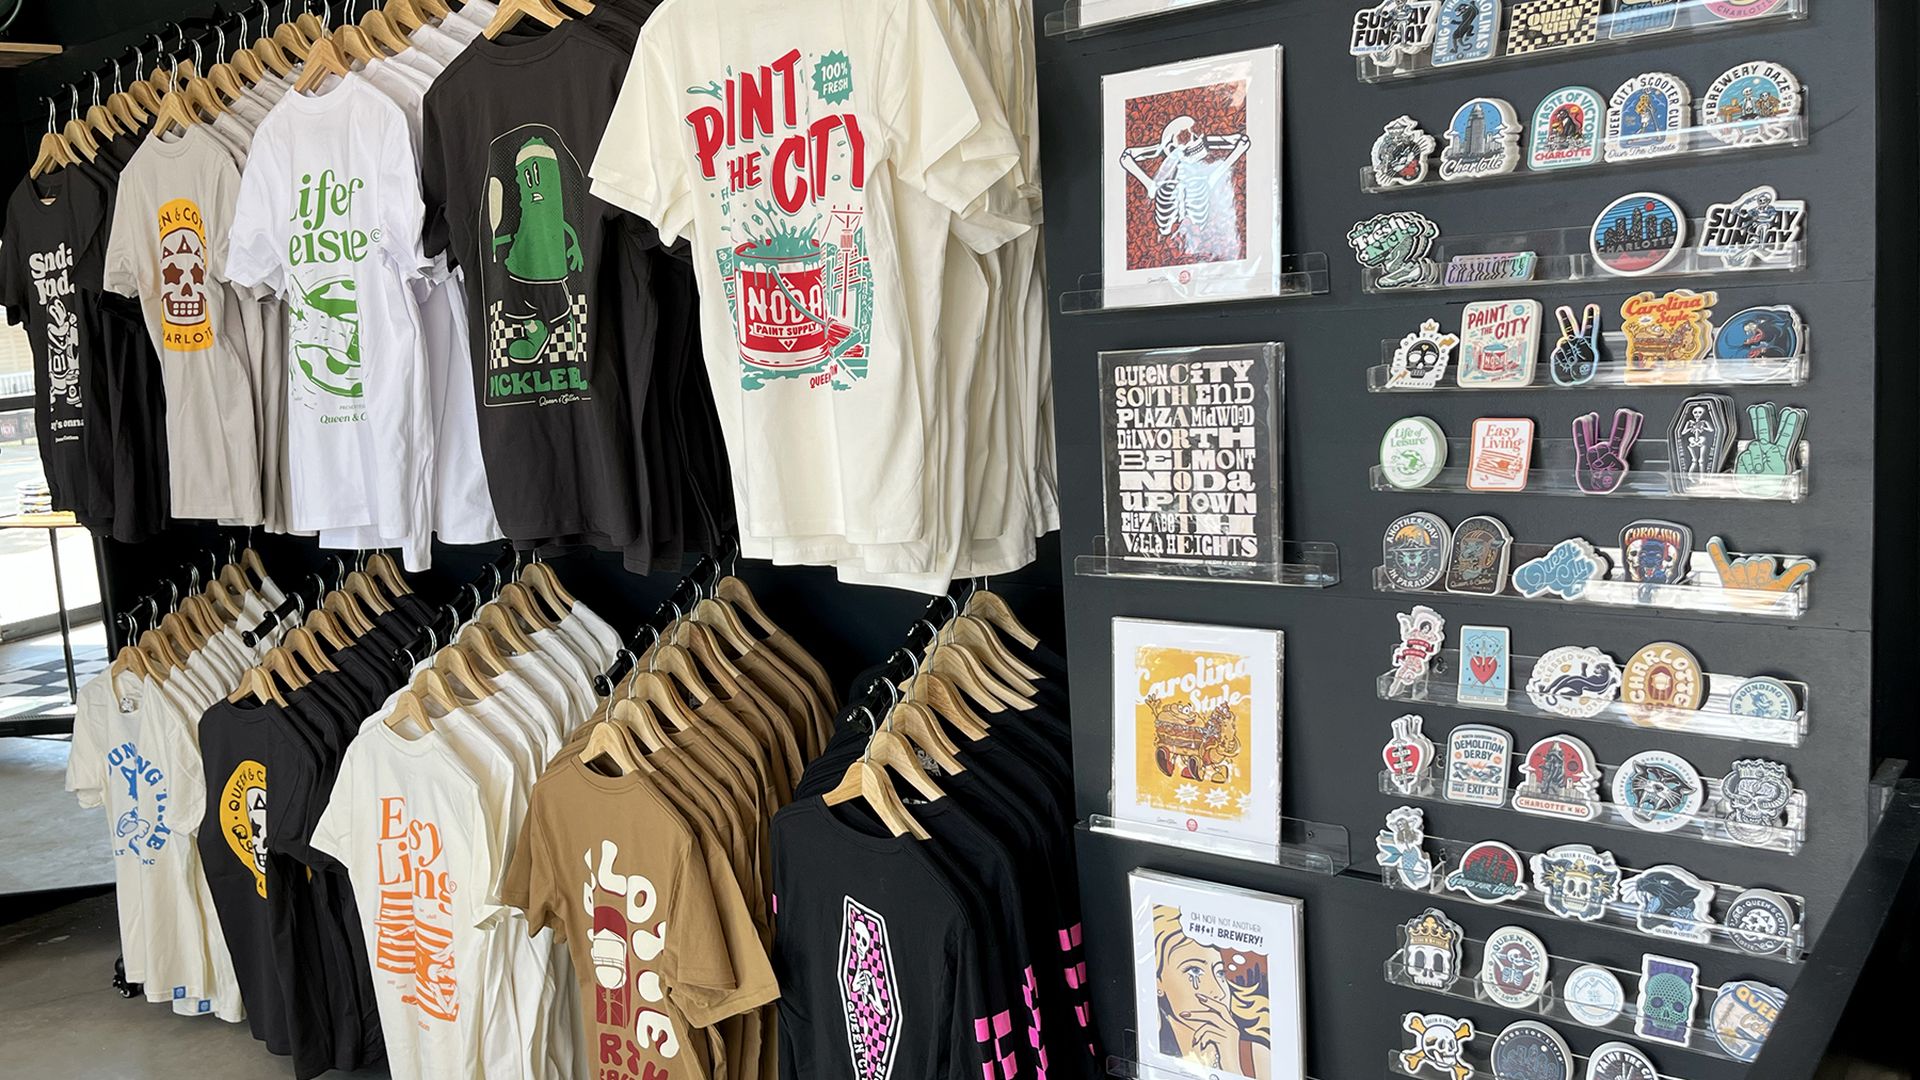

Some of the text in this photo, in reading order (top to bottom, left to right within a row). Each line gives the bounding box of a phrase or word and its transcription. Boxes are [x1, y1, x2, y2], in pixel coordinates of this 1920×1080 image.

[1528, 5, 1584, 26] QUEEN
[1435, 29, 1450, 57] KING
[821, 61, 848, 82] 100%
[822, 77, 849, 95] FRESH
[1613, 83, 1634, 106] CITY
[1640, 77, 1680, 106] SCOOTER
[1668, 109, 1679, 130] CLU
[1536, 92, 1597, 151] THE TASTE OF VICTORY
[1535, 146, 1592, 161] CHARLOTTE
[1443, 153, 1505, 177] Charlotte
[1597, 235, 1675, 254] CHARLOTTE
[1468, 304, 1508, 329] PAINT
[1626, 296, 1702, 317] Carolina
[756, 322, 818, 336] PAINT SUPPLY
[1481, 316, 1531, 340] THE CITY
[1656, 310, 1695, 327] Style
[1115, 386, 1190, 407] SOUTH
[320, 415, 350, 425] Queen
[1116, 406, 1190, 429] PLAZA
[1395, 426, 1424, 439] Life of
[1486, 424, 1520, 439] Easy
[1481, 434, 1522, 453] Living
[1118, 449, 1256, 471] BELMONT
[1424, 522, 1439, 540] DAY
[1166, 534, 1258, 558] HEIGHTS
[1397, 566, 1437, 588] PARADISE
[1524, 543, 1582, 591] Queen
[1135, 656, 1251, 707] Carolina
[1736, 683, 1783, 702] POUNDING
[1454, 740, 1505, 754] DEMOLITION
[1464, 750, 1493, 760] DERBY
[1466, 784, 1486, 795] EXIT
[1486, 785, 1499, 797] 3A
[1520, 799, 1587, 814] CHARLOTTE NC
[1745, 899, 1771, 909] QUEEN
[1190, 911, 1201, 921] OH
[1218, 917, 1232, 927] NOT
[1231, 920, 1263, 933] ANOTHER
[1217, 928, 1264, 948] BREWERY!
[1493, 934, 1541, 964] QUEEN CITY
[847, 1001, 865, 1054] QUEEN
[1596, 1051, 1621, 1074] PAINT
[1624, 1053, 1642, 1068] THE
